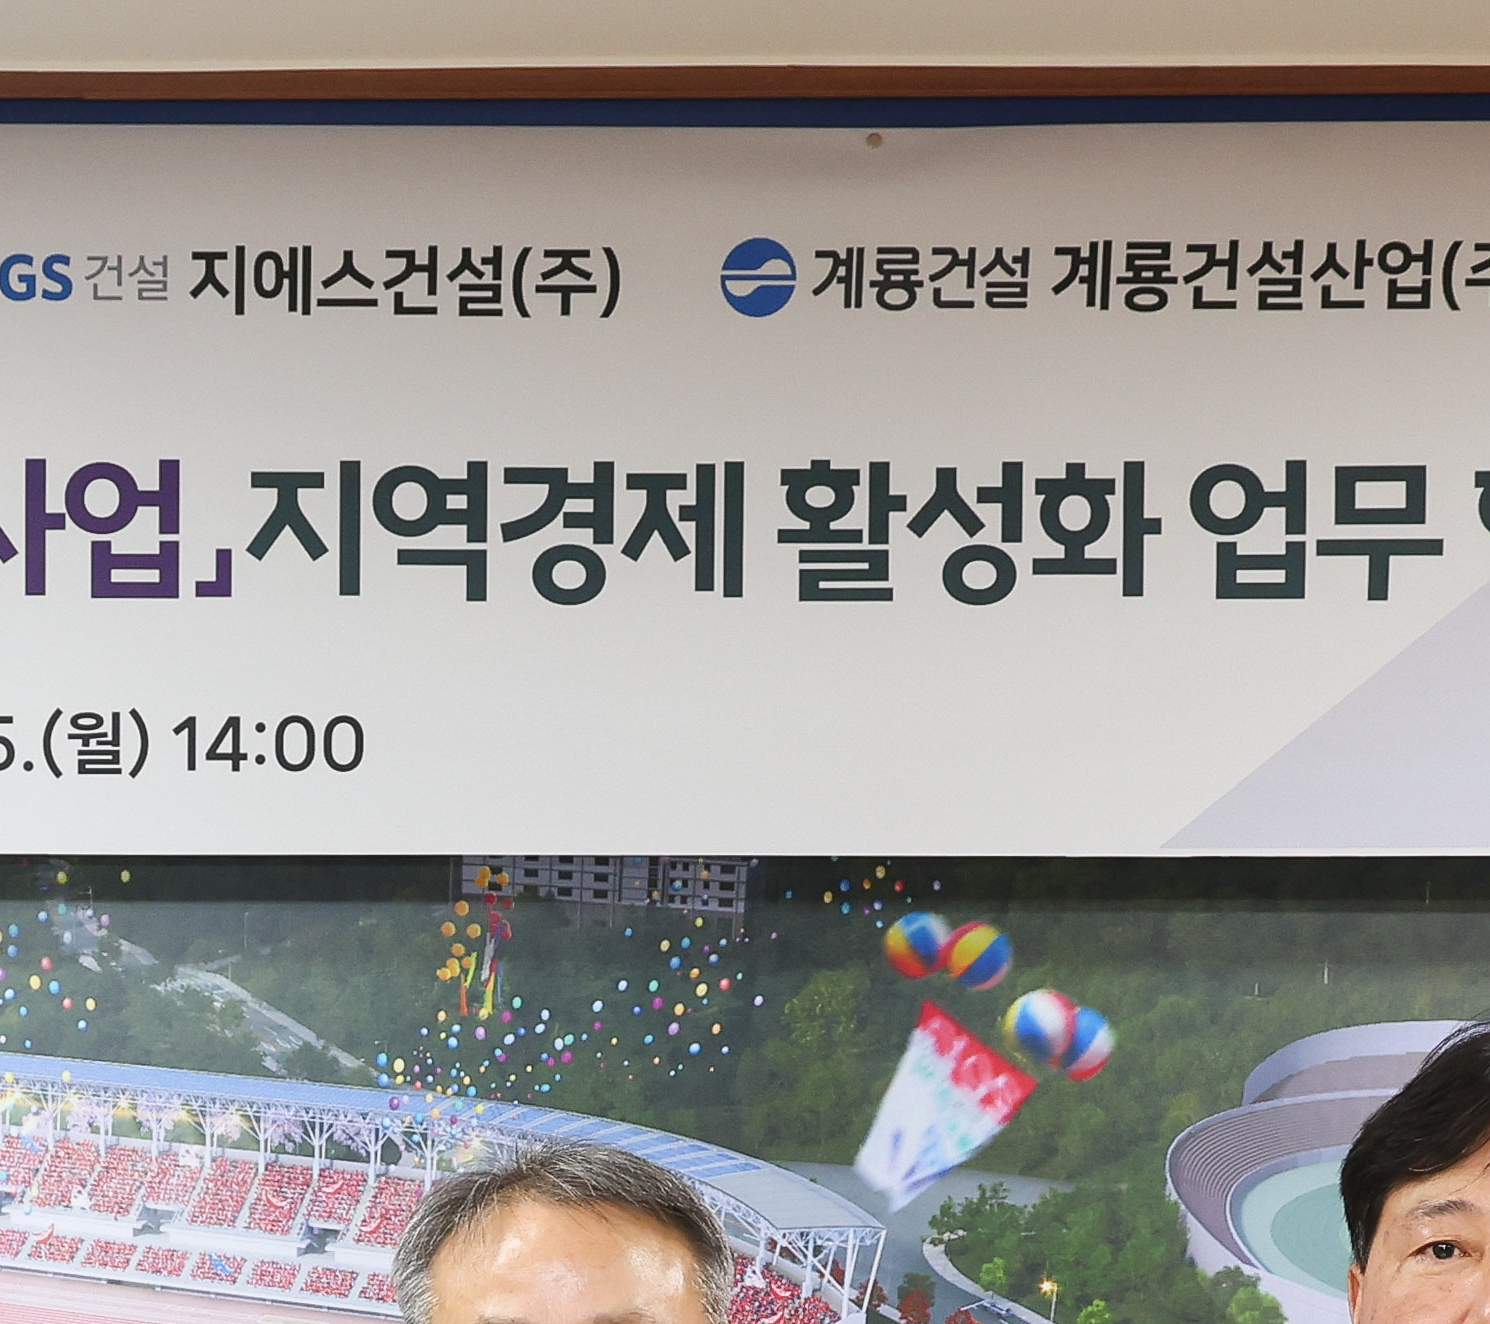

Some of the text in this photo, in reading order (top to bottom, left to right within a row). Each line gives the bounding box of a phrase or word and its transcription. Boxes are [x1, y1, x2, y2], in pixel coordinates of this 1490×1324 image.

[82, 248, 171, 304] 건설
[187, 238, 623, 317] 지에스건설(주)
[812, 241, 1031, 313] 계룡건설
[774, 455, 1163, 609] 활성화
[1187, 455, 1447, 603] 업무
[170, 713, 367, 774] 14:00
